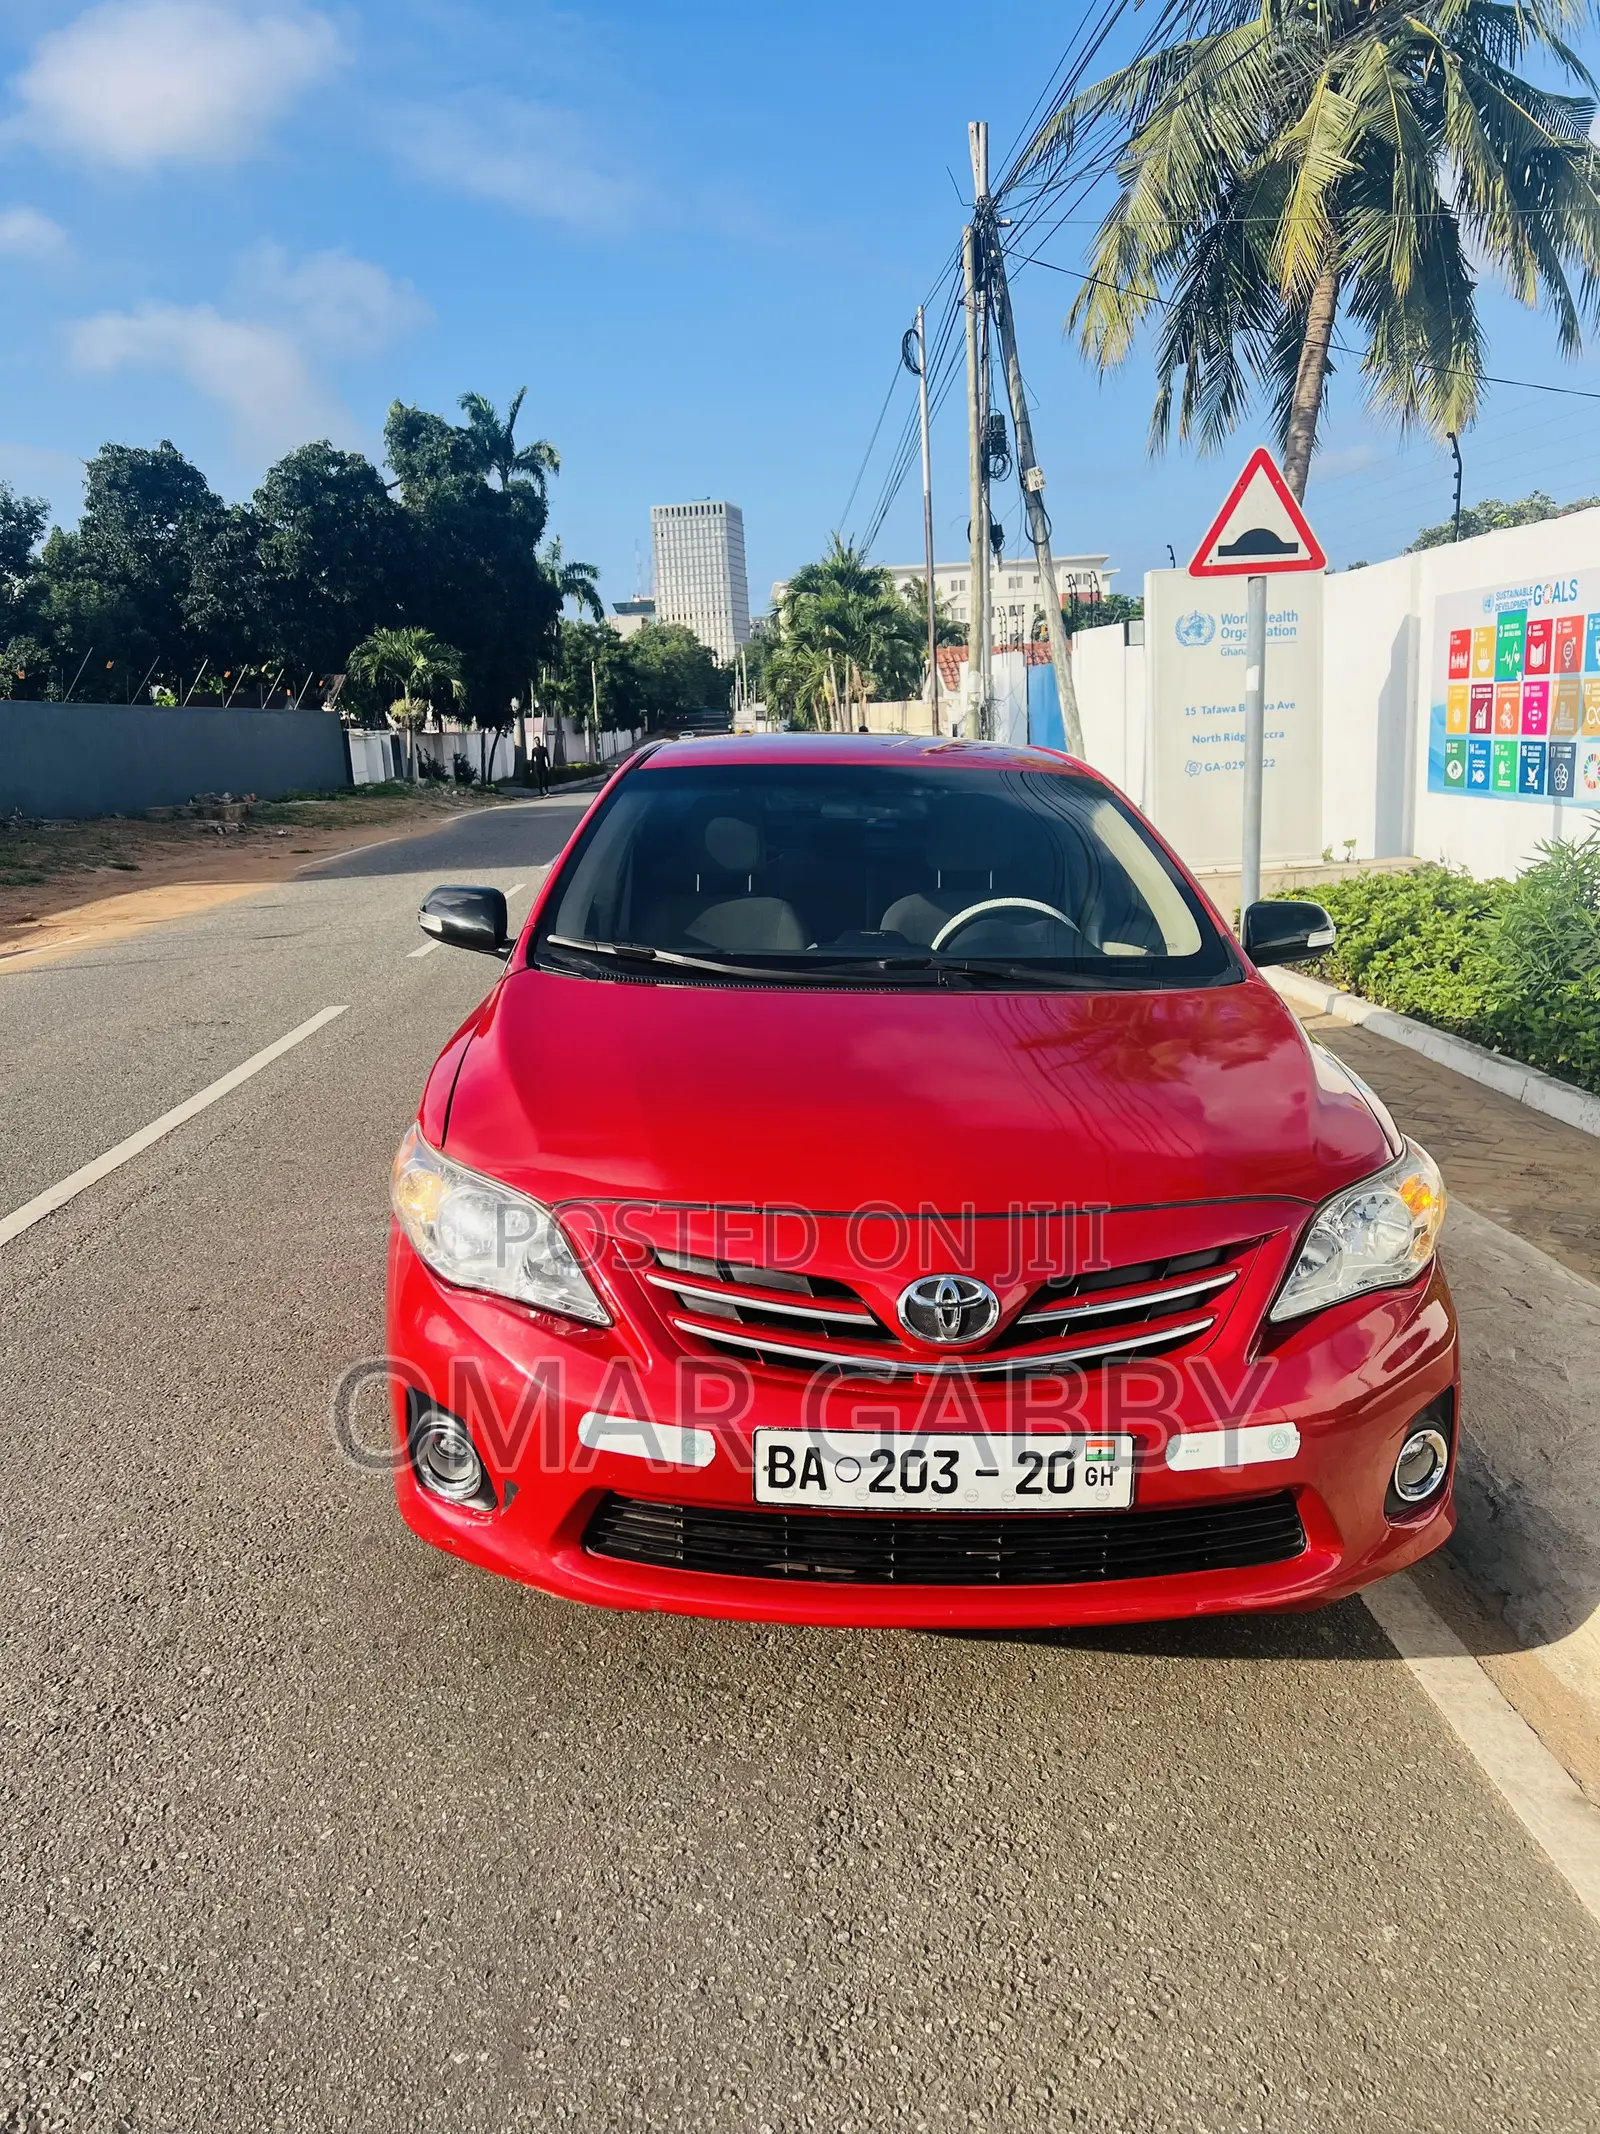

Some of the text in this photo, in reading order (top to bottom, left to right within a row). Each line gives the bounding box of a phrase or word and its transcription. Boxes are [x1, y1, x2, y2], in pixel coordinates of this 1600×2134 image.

[1495, 579, 1578, 606] SUSTAINABLE GOALS
[1494, 598, 1533, 612] DEVELOPMENT
[1220, 611, 1248, 625] Worl
[1220, 625, 1297, 641] Orgaation
[1184, 707, 1197, 716] 15
[1201, 704, 1237, 715] Tafawa
[1277, 701, 1296, 710] Ave
[1191, 731, 1285, 744] North Ridg ccra
[767, 1445, 827, 1490] BA
[868, 1449, 960, 1494] 203
[1015, 1450, 1075, 1495] 20
[1085, 1466, 1114, 1487] GH
